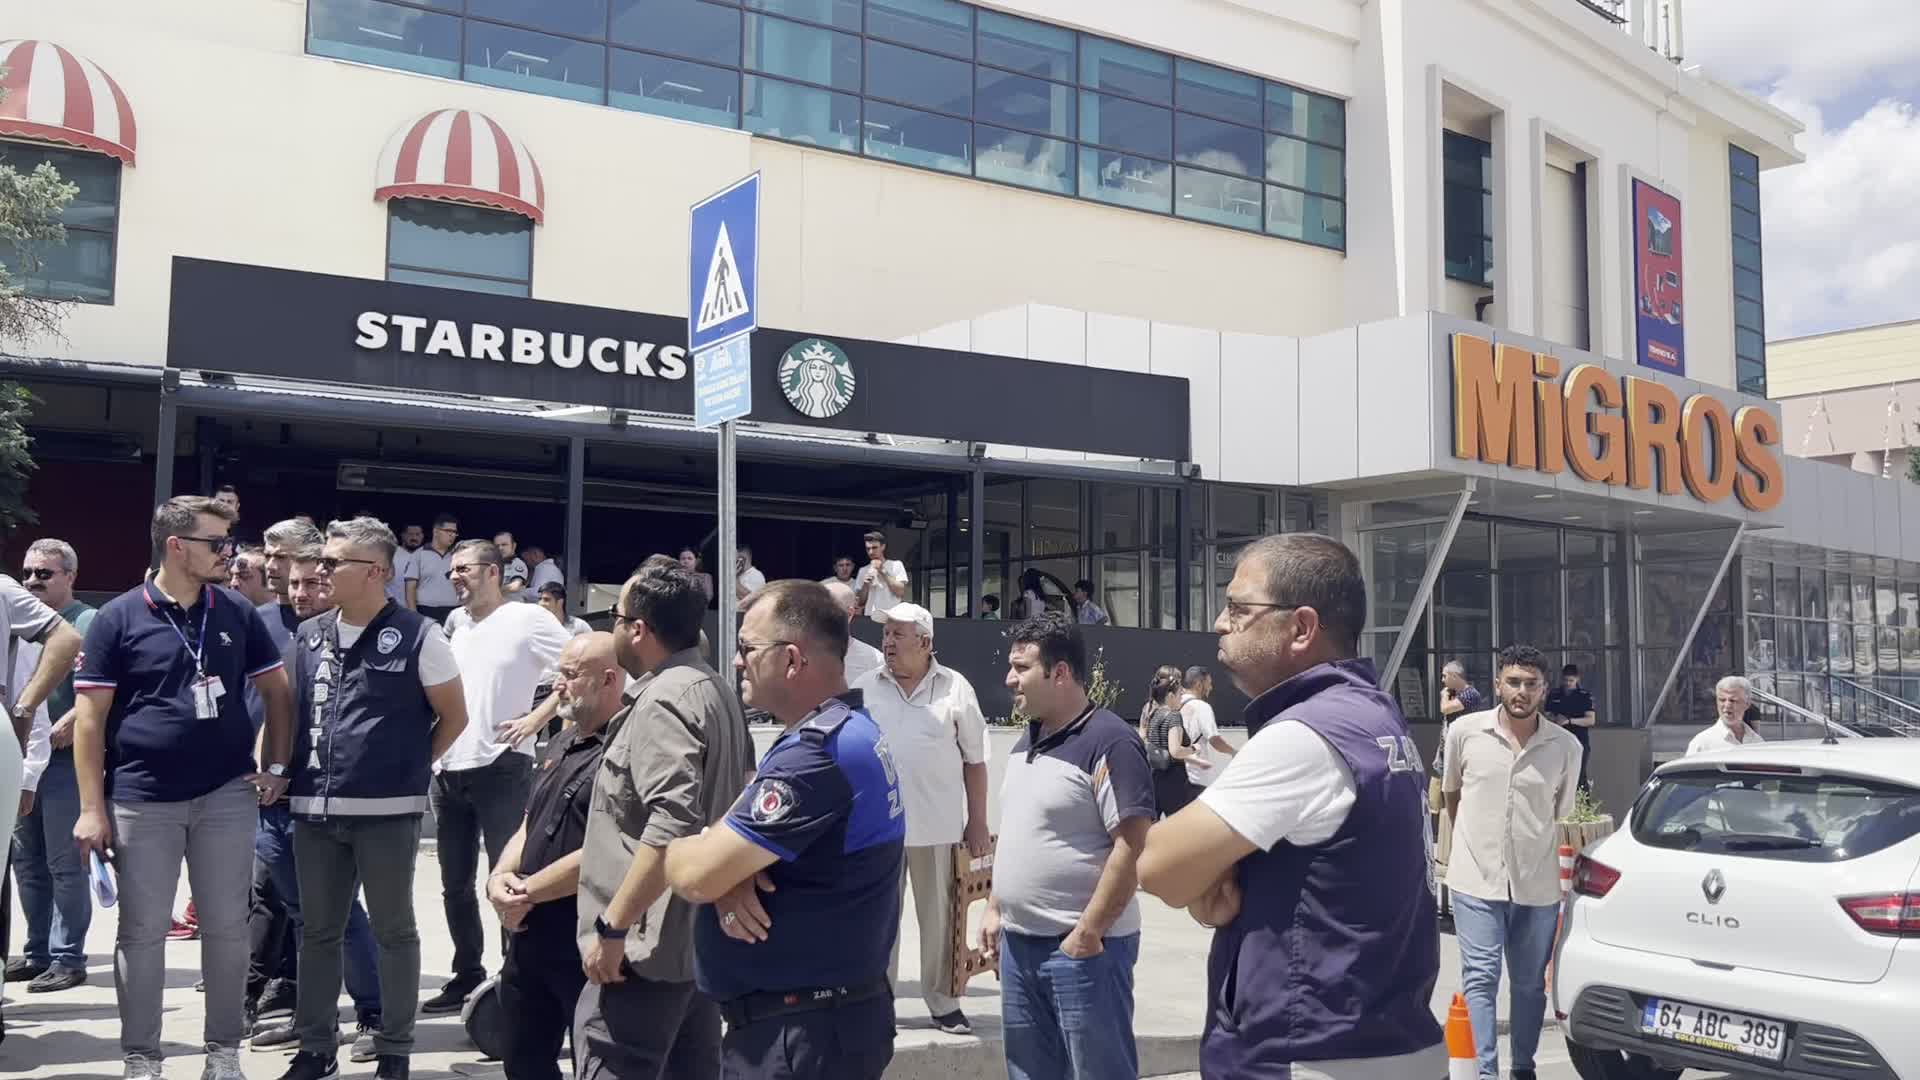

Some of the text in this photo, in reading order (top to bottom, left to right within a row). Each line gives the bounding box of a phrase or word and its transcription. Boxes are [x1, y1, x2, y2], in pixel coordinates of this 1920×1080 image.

[355, 311, 688, 380] STARBUCKS
[1686, 911, 1740, 928] CLIO
[813, 985, 848, 1000] ZABA
[1660, 1003, 1779, 1049] 64 ABC 389
